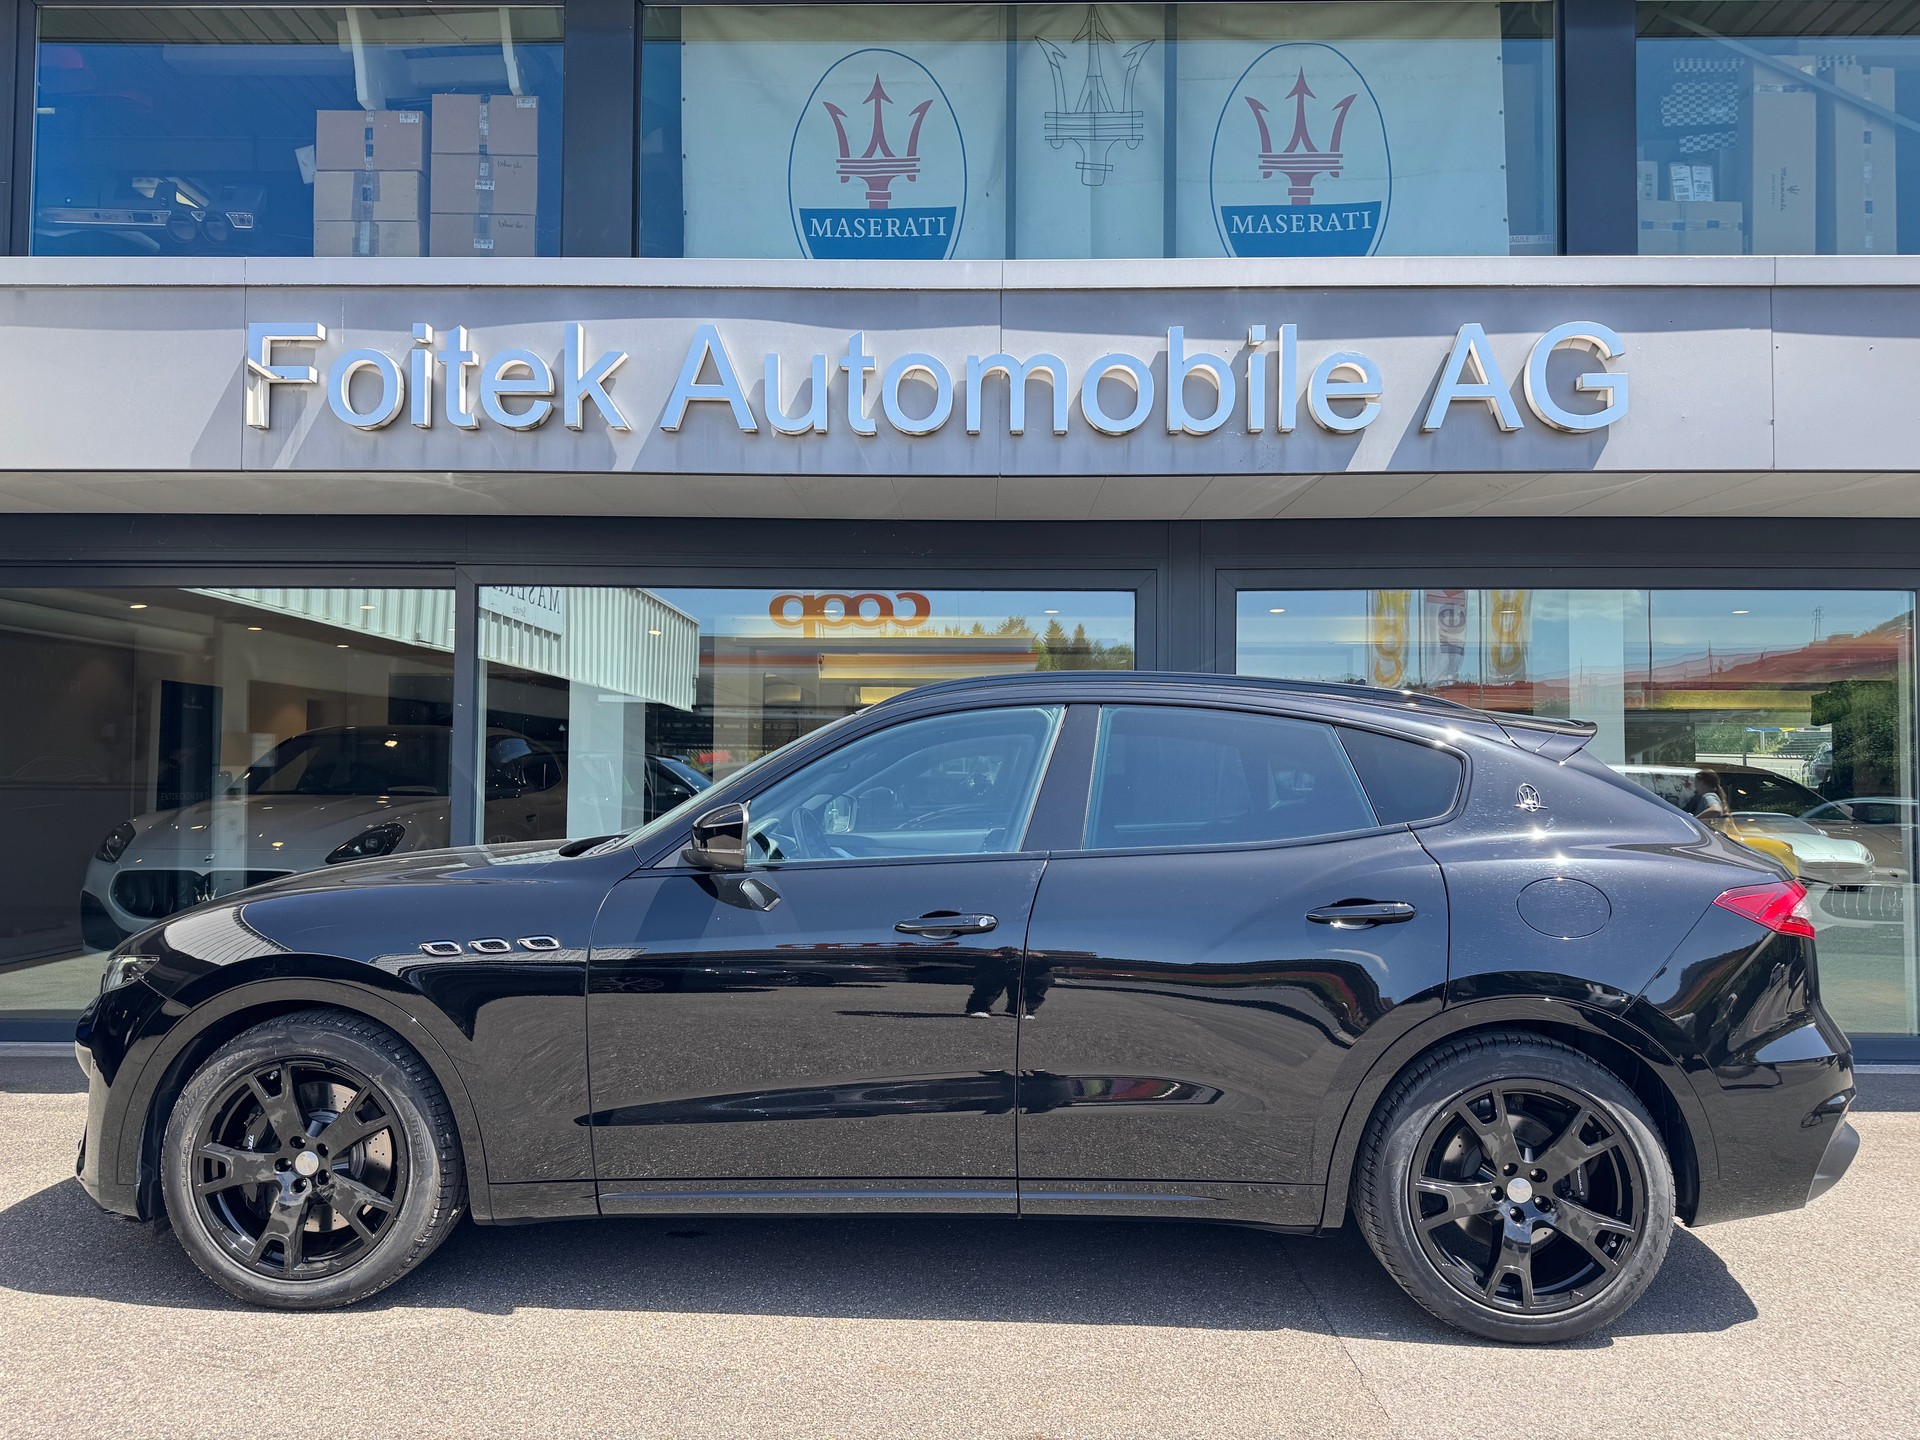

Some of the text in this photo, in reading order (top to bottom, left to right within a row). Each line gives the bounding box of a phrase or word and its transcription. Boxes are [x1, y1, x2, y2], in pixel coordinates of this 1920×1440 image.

[809, 215, 947, 240] MASERATI
[1229, 209, 1373, 236] MASERATI
[247, 320, 1629, 436] Foitek Automobile AG
